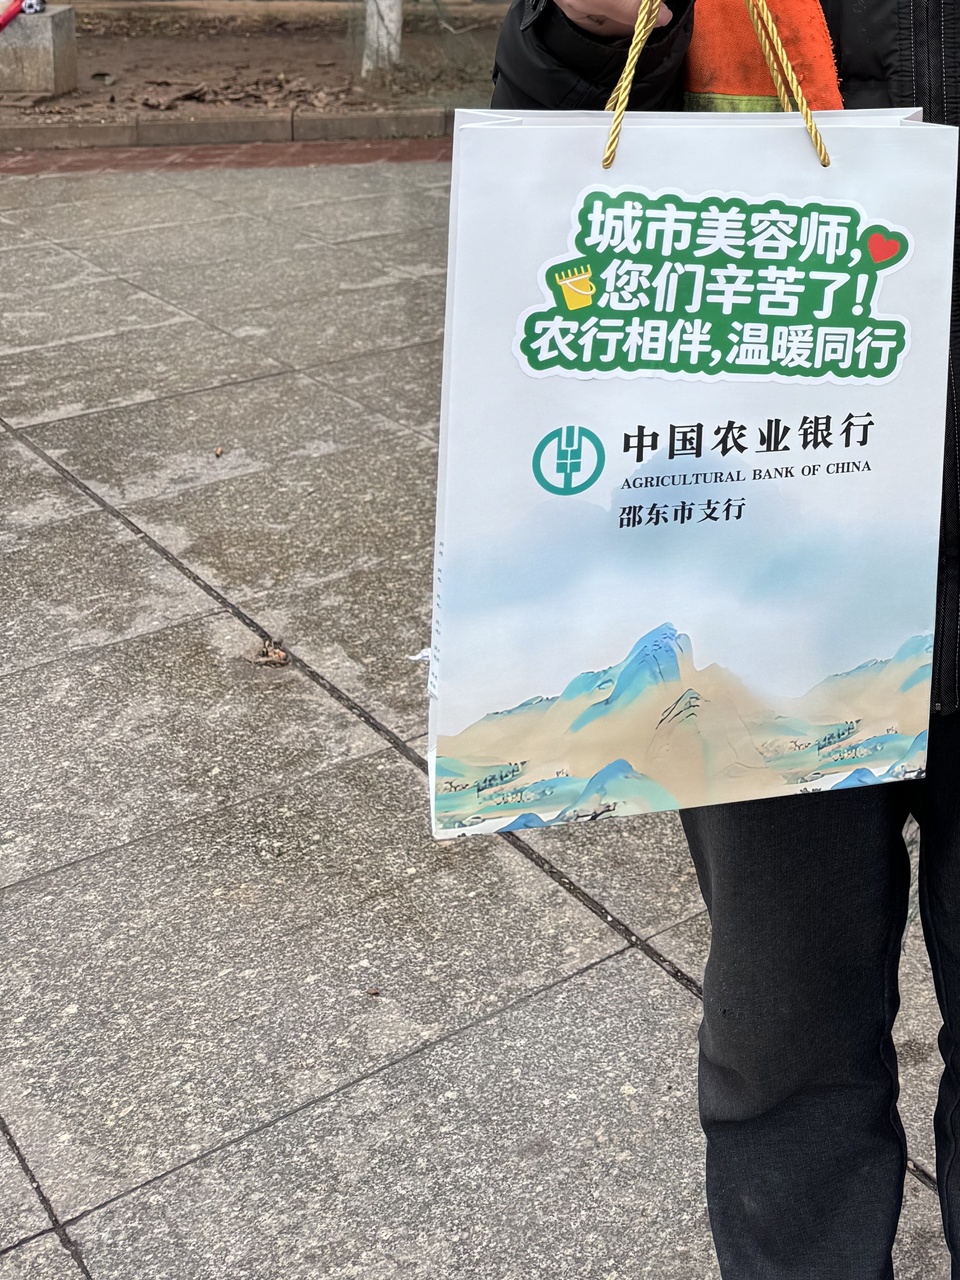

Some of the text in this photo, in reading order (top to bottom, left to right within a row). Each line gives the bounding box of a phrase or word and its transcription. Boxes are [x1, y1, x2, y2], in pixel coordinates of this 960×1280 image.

[584, 200, 862, 267] 城市美容师,
[597, 259, 869, 320] 您们辛苦了!
[529, 315, 898, 370] 农行相伴,温暖同行
[623, 411, 875, 464] 中国农业银行
[621, 460, 872, 490] AGRICULTURAL BANK OF CHINA
[618, 496, 746, 529] 邵东市支行
